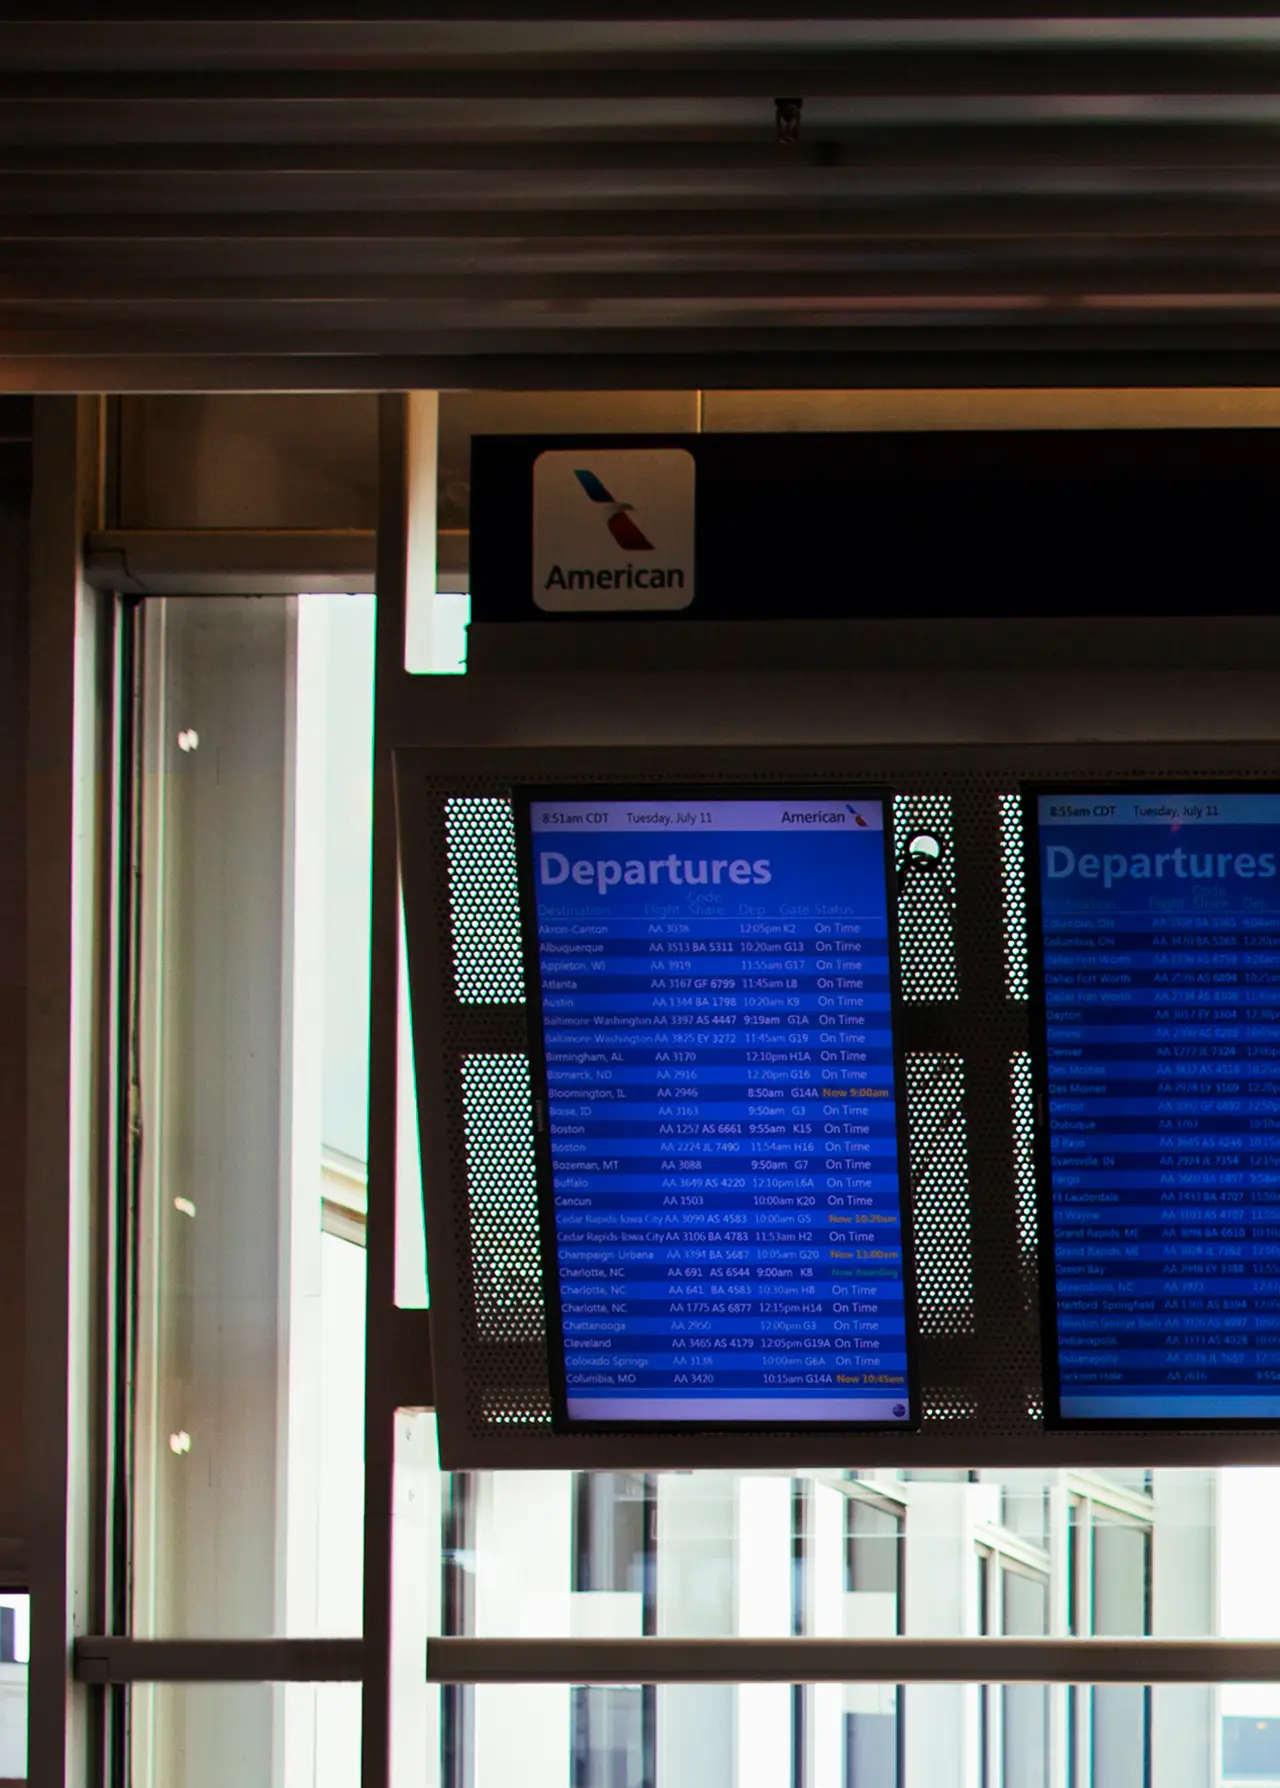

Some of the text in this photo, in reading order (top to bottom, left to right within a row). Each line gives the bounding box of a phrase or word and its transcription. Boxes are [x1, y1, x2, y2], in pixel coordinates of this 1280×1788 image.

[544, 563, 684, 591] American
[782, 811, 845, 823] American
[1049, 806, 1218, 819] 8:55am CDT Tuesday, July 11
[542, 813, 712, 826] 8:51am CDT Tuesday, July 11
[1046, 845, 1276, 888] Departures
[540, 852, 772, 895] Departures
[689, 904, 725, 915] Share
[739, 904, 766, 919] Dep
[779, 904, 809, 915] Gate
[815, 904, 854, 915] Status
[540, 942, 604, 954] Albuquerque
[649, 942, 664, 951] AA
[667, 942, 690, 951] 3513
[693, 942, 708, 951] BA
[710, 942, 733, 951] 5311
[784, 942, 804, 951] G13
[816, 942, 833, 951] On
[836, 942, 861, 951] Time
[542, 979, 577, 988] Atlanta
[651, 979, 666, 988] AA
[669, 979, 692, 988] 3167
[711, 979, 735, 988] 6799
[787, 979, 797, 988] L8
[817, 979, 833, 988] On
[837, 979, 863, 988] Time
[1047, 1010, 1081, 1021] Dayton
[611, 1052, 624, 1061] AL
[655, 1052, 670, 1061] AA
[673, 1052, 696, 1061] 3170
[746, 1052, 788, 1063] 12:10pm
[790, 1052, 811, 1061] H1A
[821, 1052, 837, 1061] On
[841, 1052, 866, 1061] Time
[551, 1125, 585, 1134] Boston
[659, 1125, 675, 1134] AA
[702, 1125, 716, 1134] AS
[719, 1125, 742, 1134] 6661
[749, 1125, 786, 1134] 9:55am
[793, 1125, 811, 1134] K15
[824, 1125, 841, 1134] On
[844, 1125, 869, 1134] Time
[555, 1196, 873, 1205] Cancun AA 1503 10:00am K20 On Time
[559, 1268, 813, 1278] Charlotte, NC AA 691 AS 6544 9:00am K8
